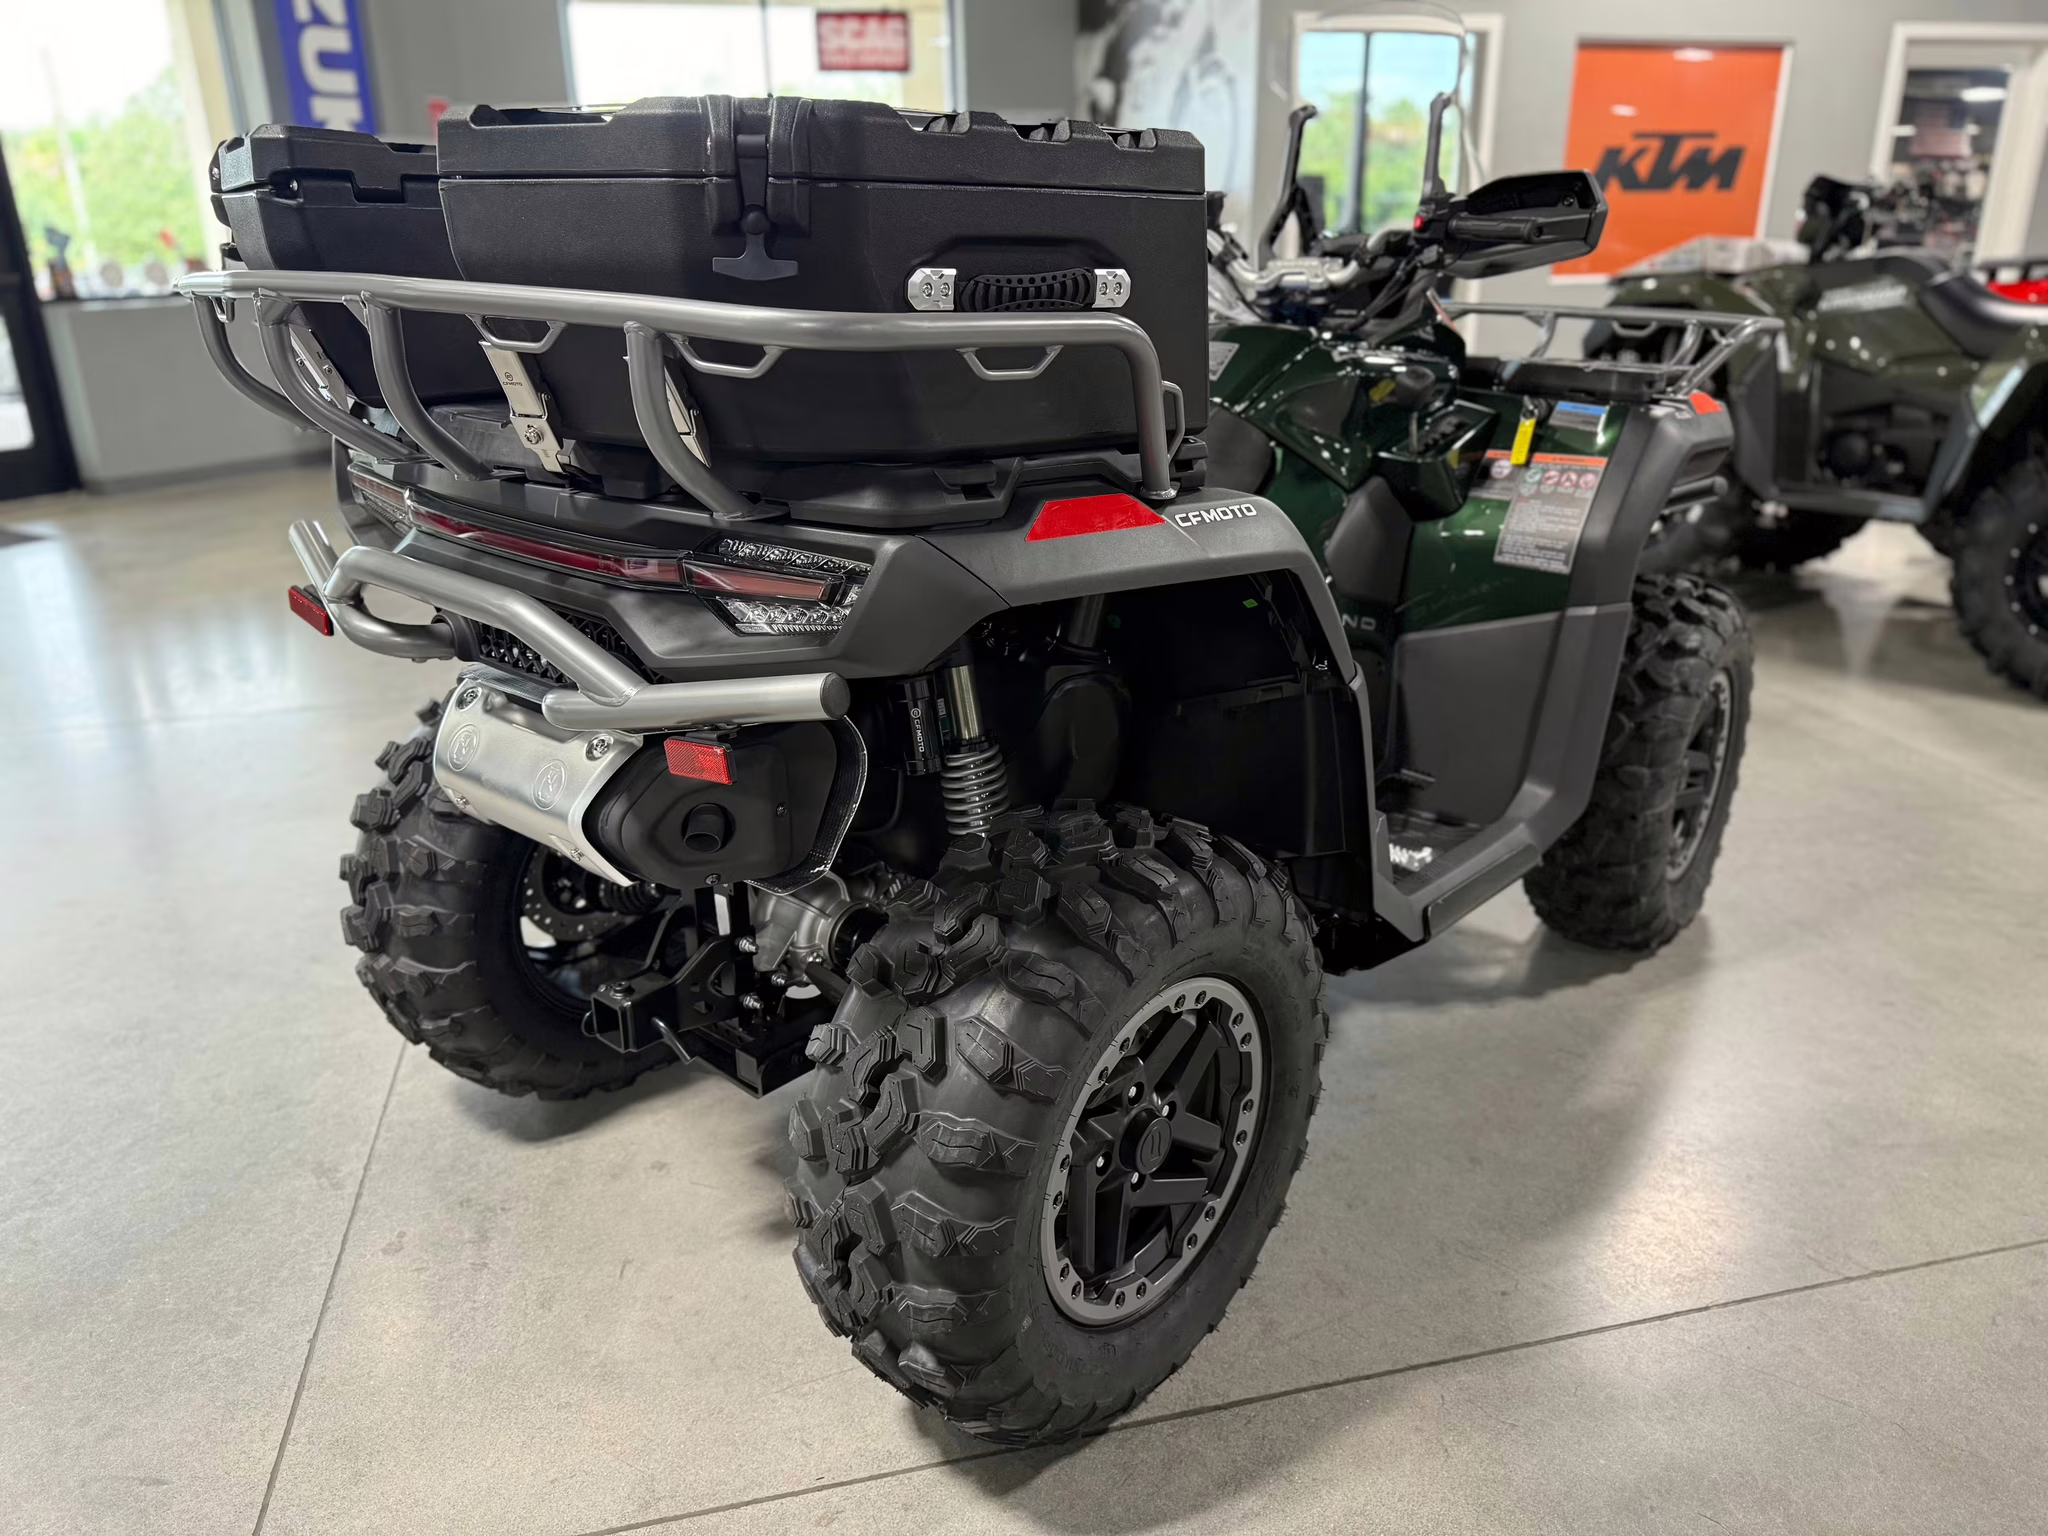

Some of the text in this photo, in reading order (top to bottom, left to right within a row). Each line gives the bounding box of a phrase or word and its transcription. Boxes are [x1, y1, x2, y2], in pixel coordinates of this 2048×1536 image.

[1595, 130, 1747, 192] KTM
[1174, 503, 1257, 528] CFMOTO
[914, 719, 925, 753] CFMOTO
